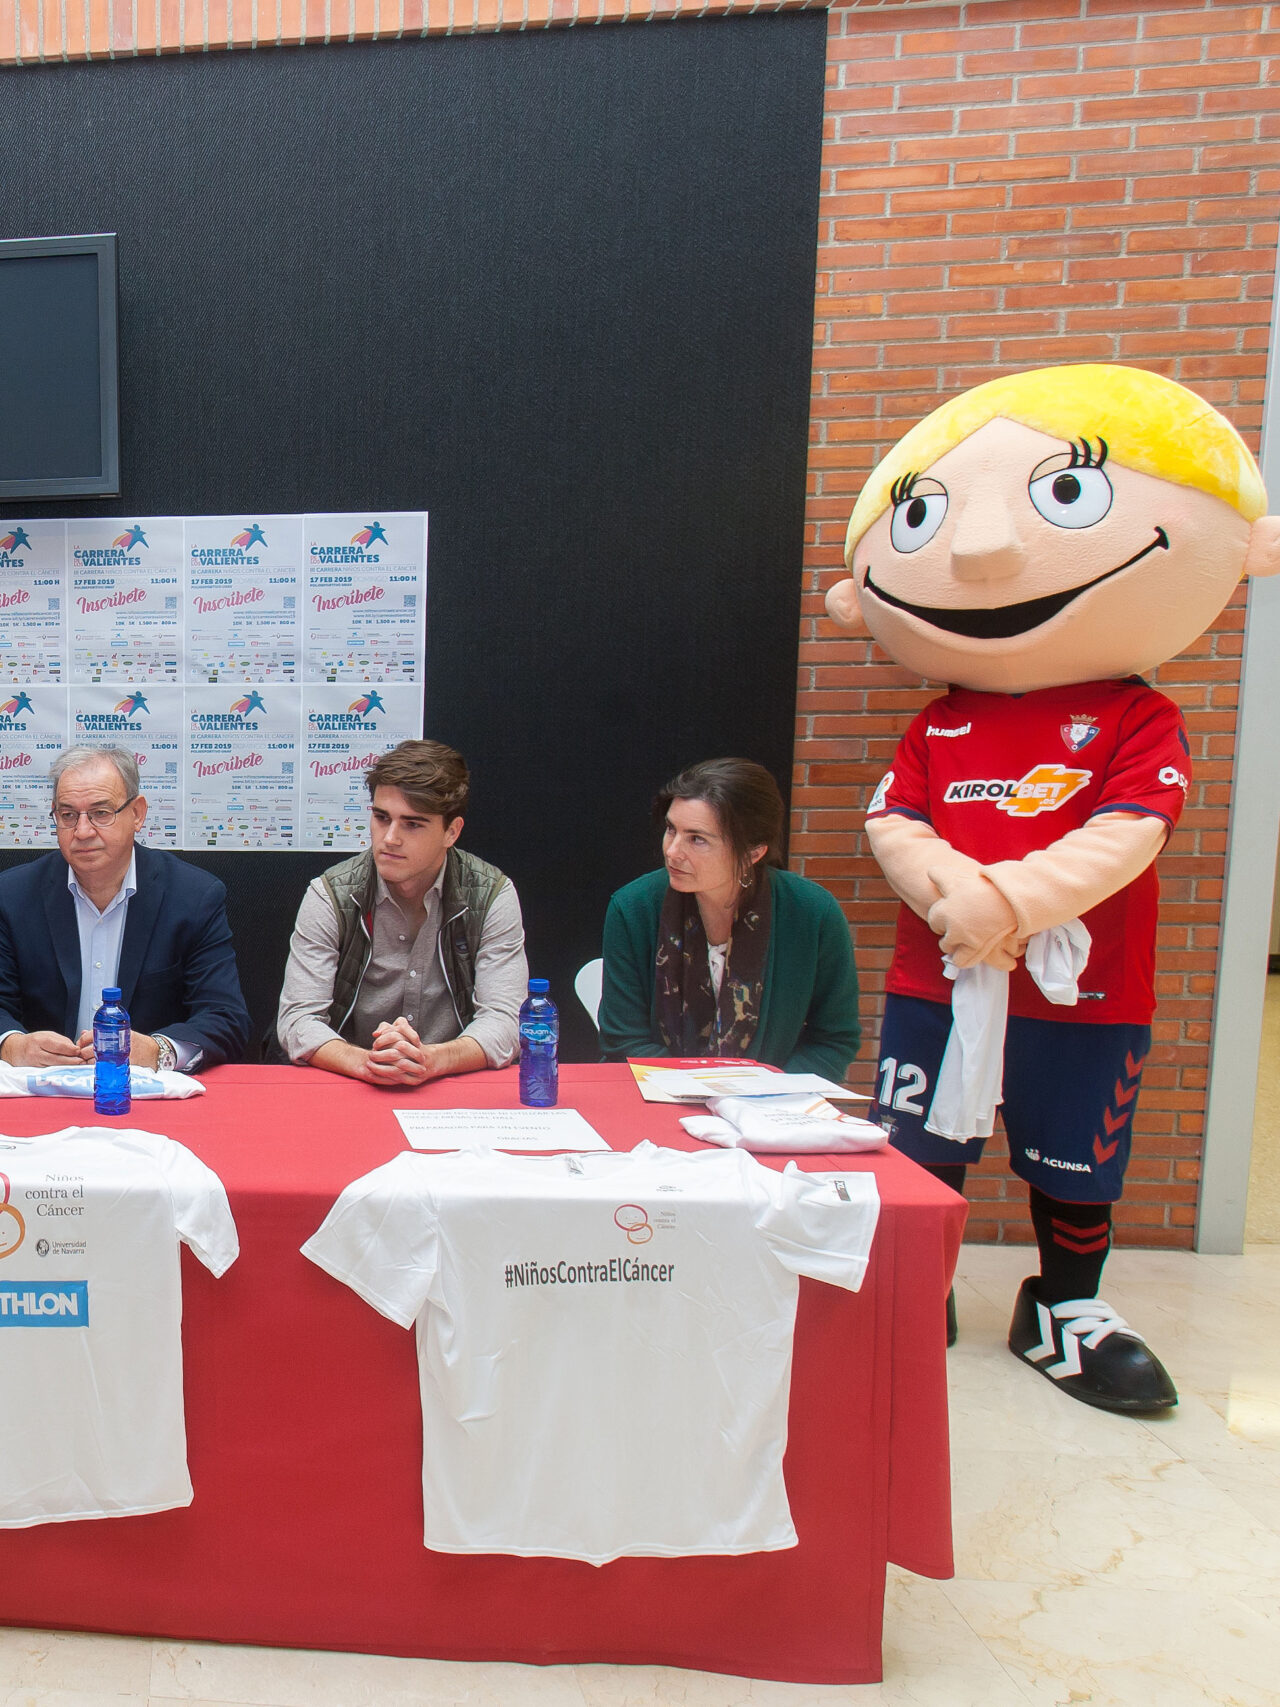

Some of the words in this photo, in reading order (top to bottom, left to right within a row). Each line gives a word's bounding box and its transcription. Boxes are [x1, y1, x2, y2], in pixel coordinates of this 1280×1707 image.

[74, 549, 125, 558] CARRERA
[191, 548, 243, 557] CARRERA
[311, 546, 363, 555] CARRERA
[82, 557, 140, 566] VALIENTES
[200, 556, 259, 565] VALIENTES
[319, 554, 379, 563] VALIENTES
[76, 587, 147, 614] Inscríbete
[193, 586, 265, 613] Inscríbete
[312, 585, 385, 612] Inscríbete
[76, 714, 126, 722] CARRERA
[191, 713, 242, 722] CARRERA
[309, 713, 361, 722] CARRERA
[84, 722, 141, 731] VALIENTES
[200, 722, 257, 731] VALIENTES
[317, 721, 376, 730] VALIENTES
[926, 722, 971, 738] hummel
[192, 751, 263, 778] Inscríbete
[949, 782, 1067, 799] KIROLBET
[878, 1056, 928, 1117] 12
[1041, 1156, 1092, 1173] ACUNSA
[45, 1174, 84, 1183] Niños
[25, 1187, 69, 1200] contra
[72, 1184, 84, 1199] el
[36, 1203, 84, 1217] Cáncer
[52, 1240, 87, 1248] Universidad
[504, 1256, 675, 1289] #NiñosContraElCáncer
